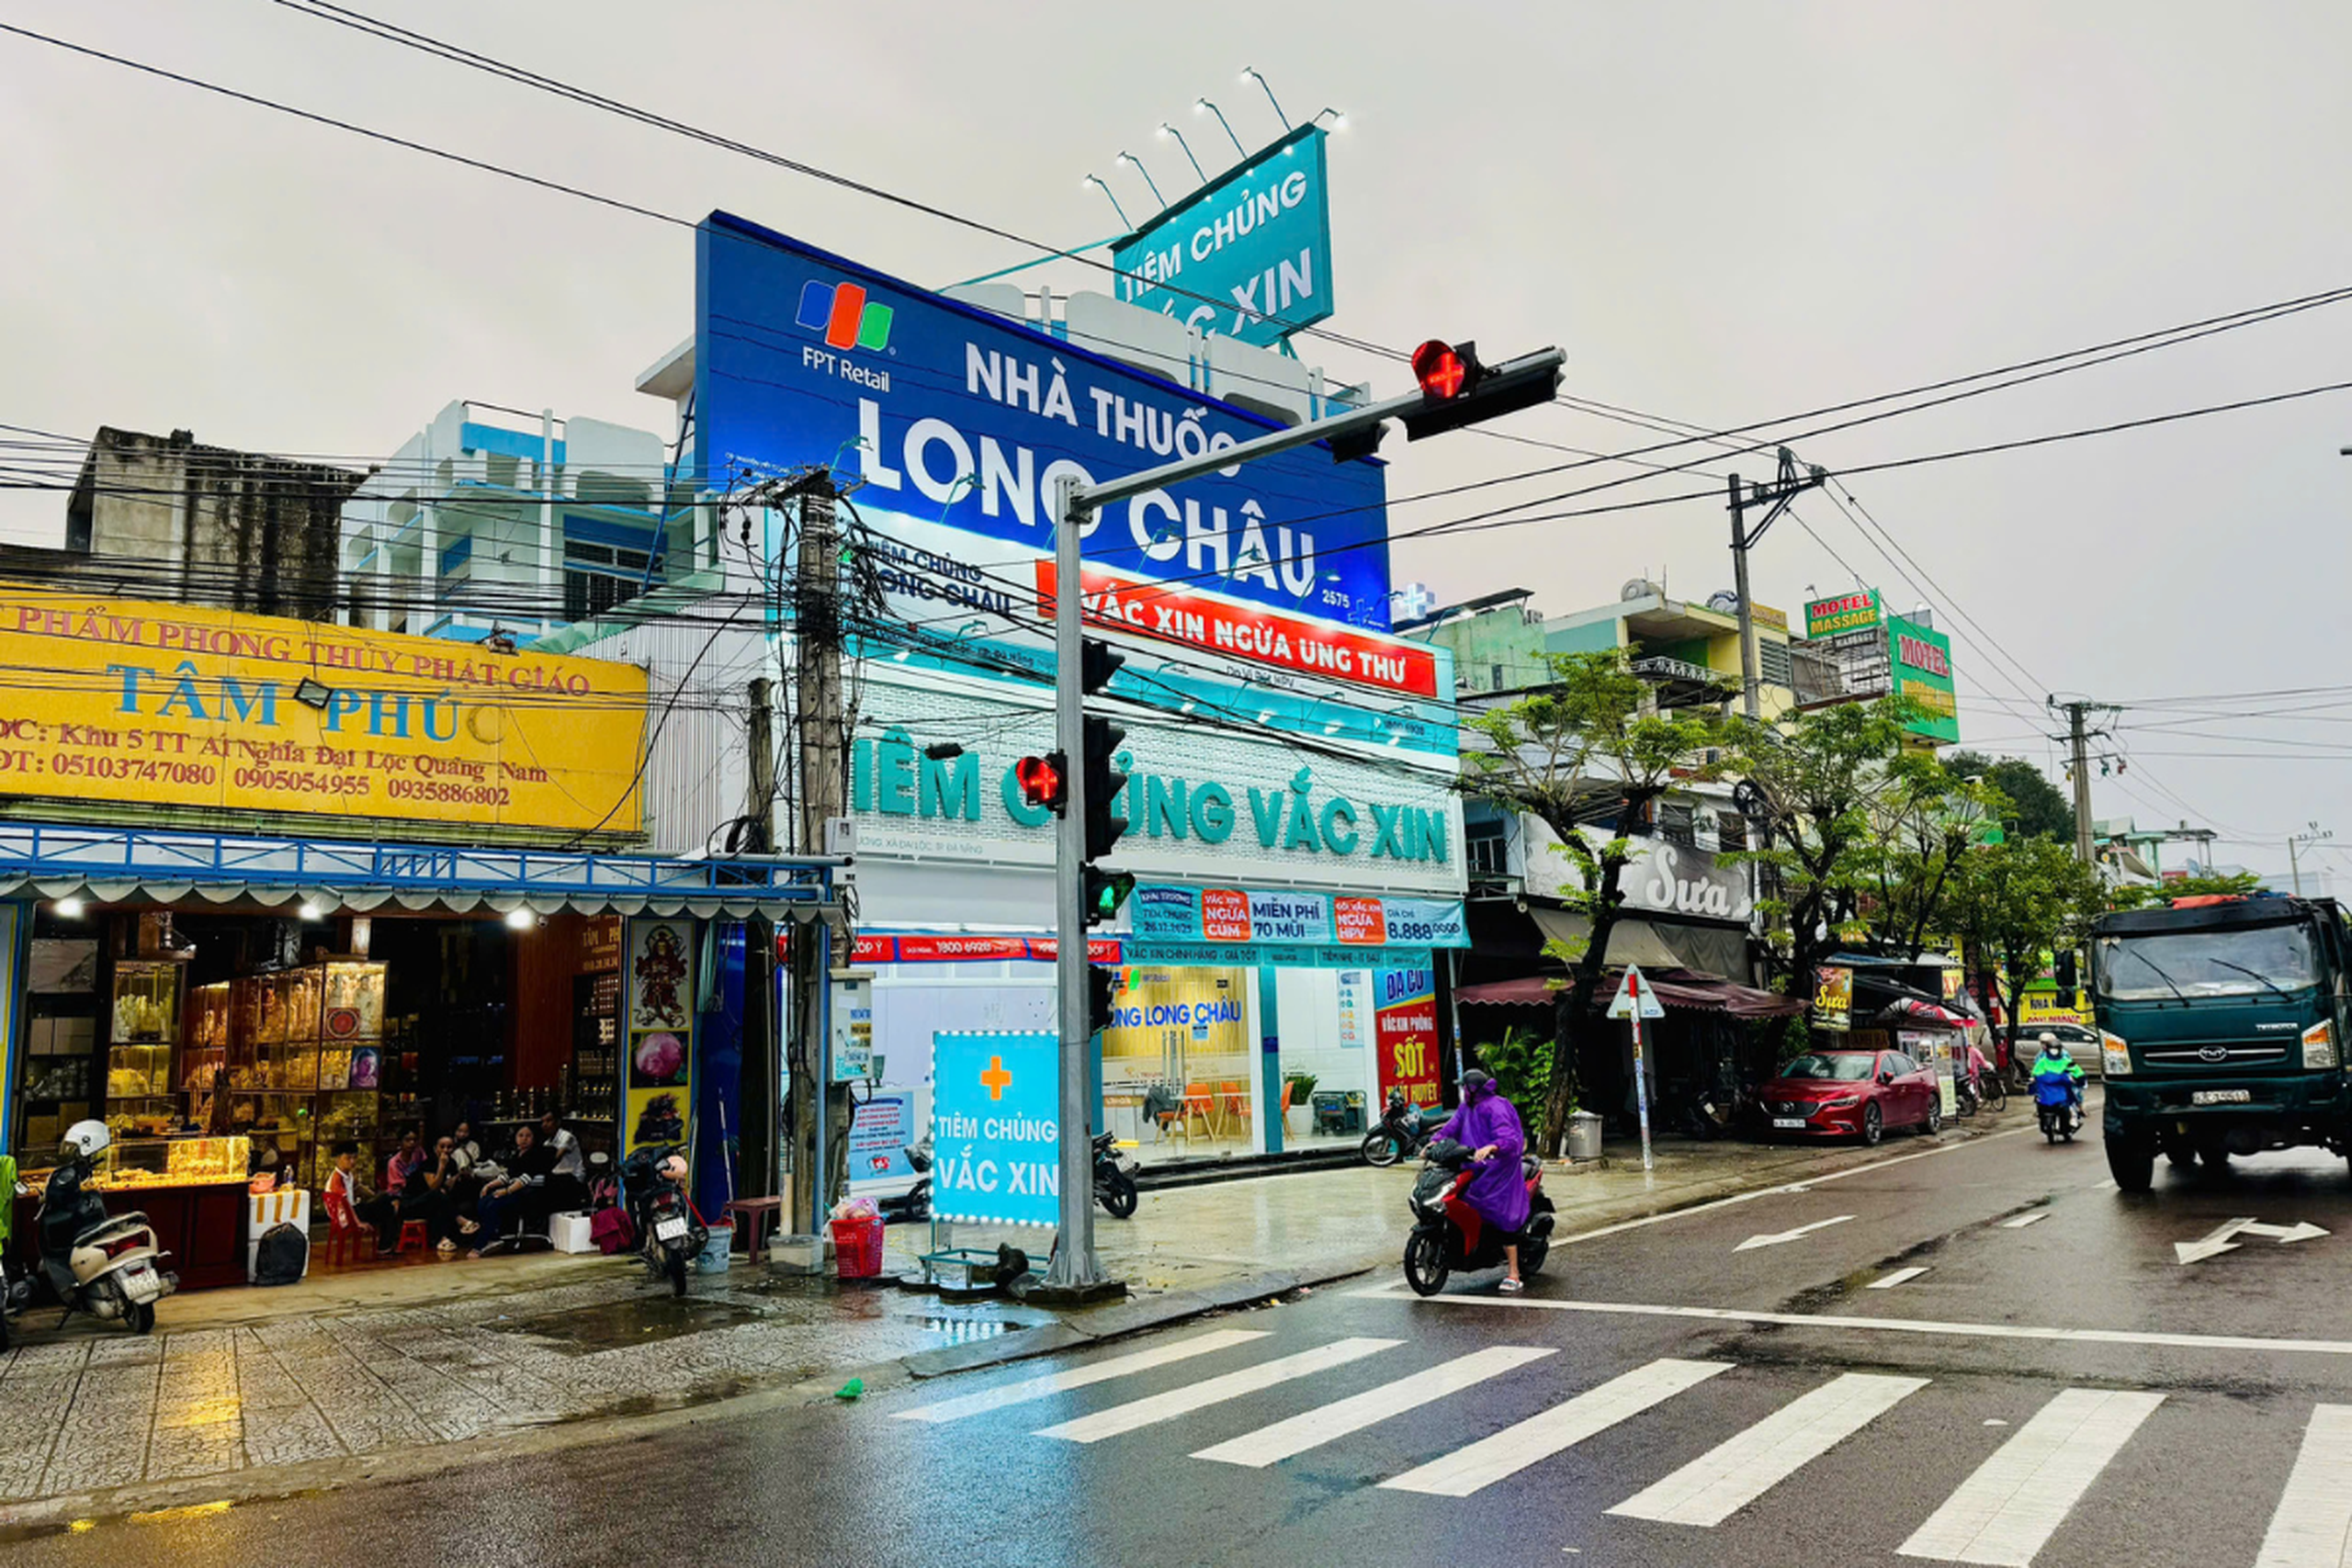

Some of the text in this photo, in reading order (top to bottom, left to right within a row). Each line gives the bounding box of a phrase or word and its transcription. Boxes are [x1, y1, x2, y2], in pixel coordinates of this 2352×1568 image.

[1121, 171, 1306, 304] TIÊM CHỦNG
[1231, 247, 1313, 336] XIN
[803, 345, 890, 393] FPT Retail
[966, 341, 1079, 427] NHÀ
[1128, 488, 1316, 598] CHÂU
[879, 569, 935, 601] ONG
[1322, 588, 1351, 609] 2575
[1812, 593, 1873, 618] MOTEL
[1154, 604, 1205, 642] XIN
[1214, 620, 1293, 661] NGỪA
[1299, 637, 1352, 672] UNG
[1358, 651, 1407, 684] THƯ
[1811, 608, 1877, 634] MASSAGE
[17, 604, 144, 644] PHẨM
[157, 622, 290, 661] PHONG
[509, 665, 591, 697] GIÁO
[1898, 633, 1951, 678] MOTEL
[107, 660, 280, 727] TÂM
[58, 722, 119, 748] Khu
[128, 729, 143, 749] 5
[148, 730, 191, 754] TT
[497, 761, 548, 784] Nam
[52, 752, 216, 785] 05103747080
[234, 766, 370, 797] 0905054955
[388, 778, 511, 807] 0935886802
[854, 726, 981, 821] IÊM
[1247, 766, 1360, 855] VẮC
[1370, 804, 1447, 863] XIN
[1252, 897, 1320, 920] MIỄN PHÍ
[1254, 919, 1306, 938] 70 MŨI
[1339, 927, 1366, 940] HPV
[1145, 1003, 1191, 1027] LONG
[1194, 995, 1242, 1024] CHÂU
[1394, 1033, 1426, 1078] SỐT
[938, 1111, 978, 1140] TIÊM
[983, 1111, 1058, 1144] CHỦNG
[937, 1143, 1059, 1197] VẮC XIN
